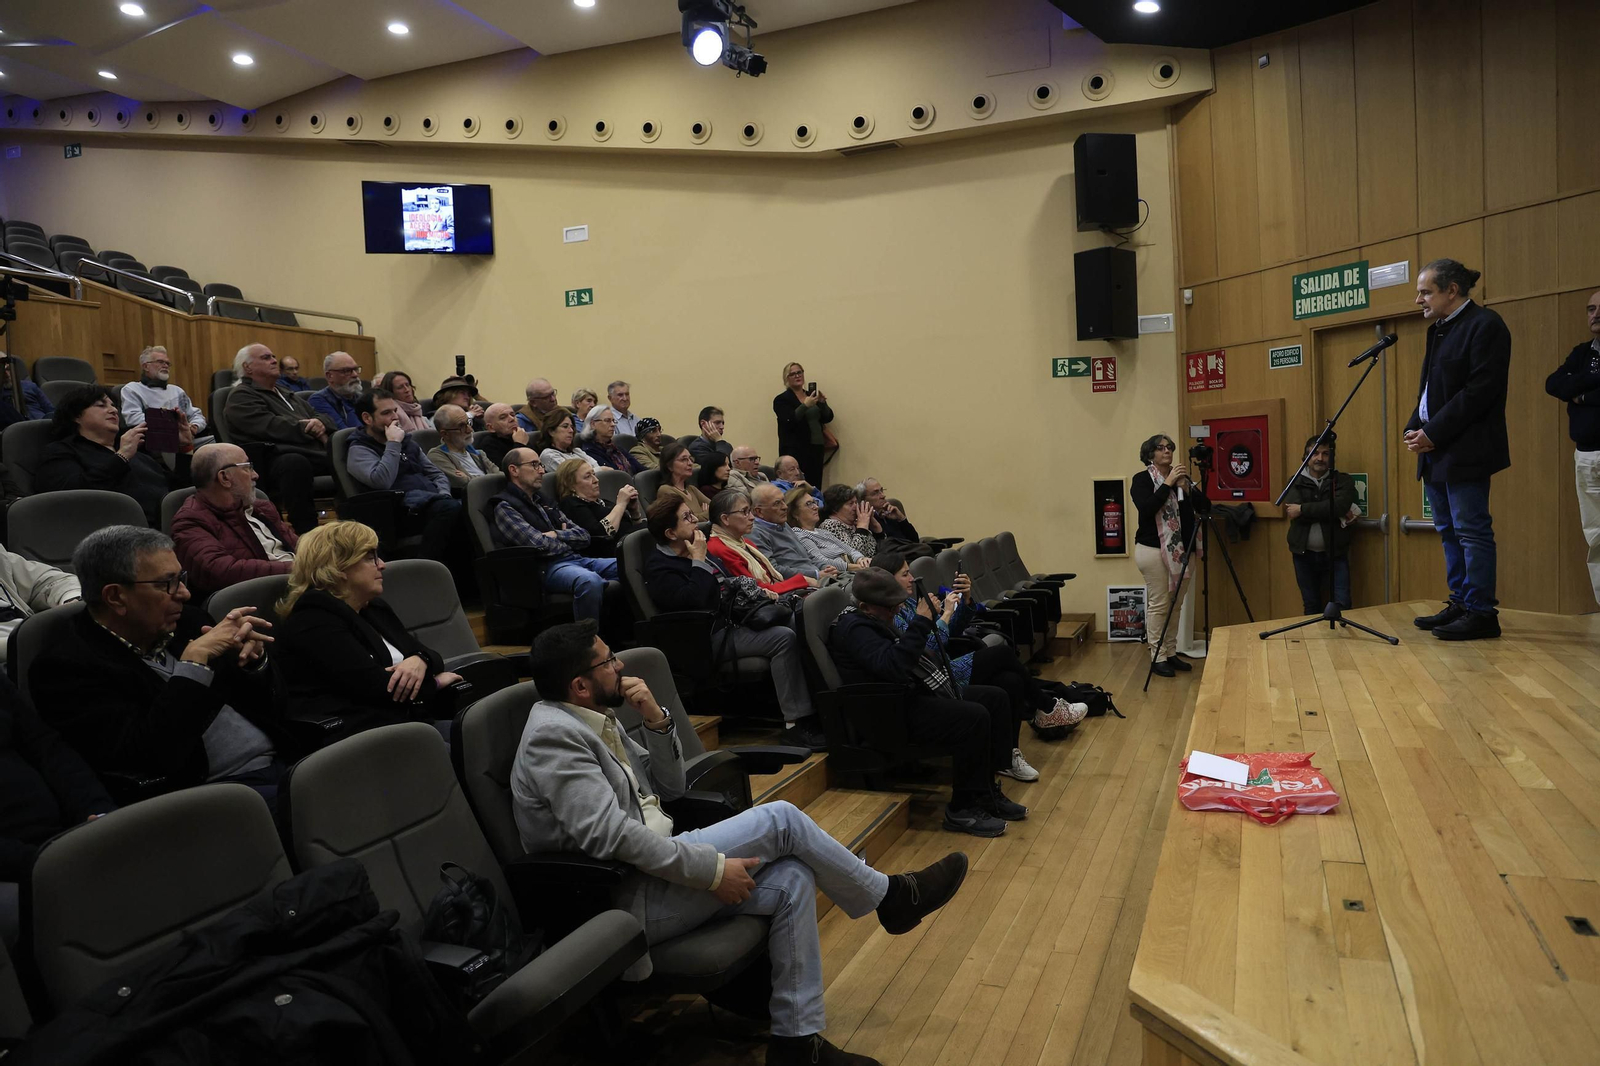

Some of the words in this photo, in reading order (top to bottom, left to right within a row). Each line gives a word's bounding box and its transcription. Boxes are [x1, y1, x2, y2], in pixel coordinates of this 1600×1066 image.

[1300, 272, 1340, 295] SALIDA
[1343, 267, 1360, 287] DE
[1295, 287, 1366, 316] EMERGENCIA
[1272, 350, 1284, 358] AFORO
[1280, 356, 1299, 365] PERSONAS
